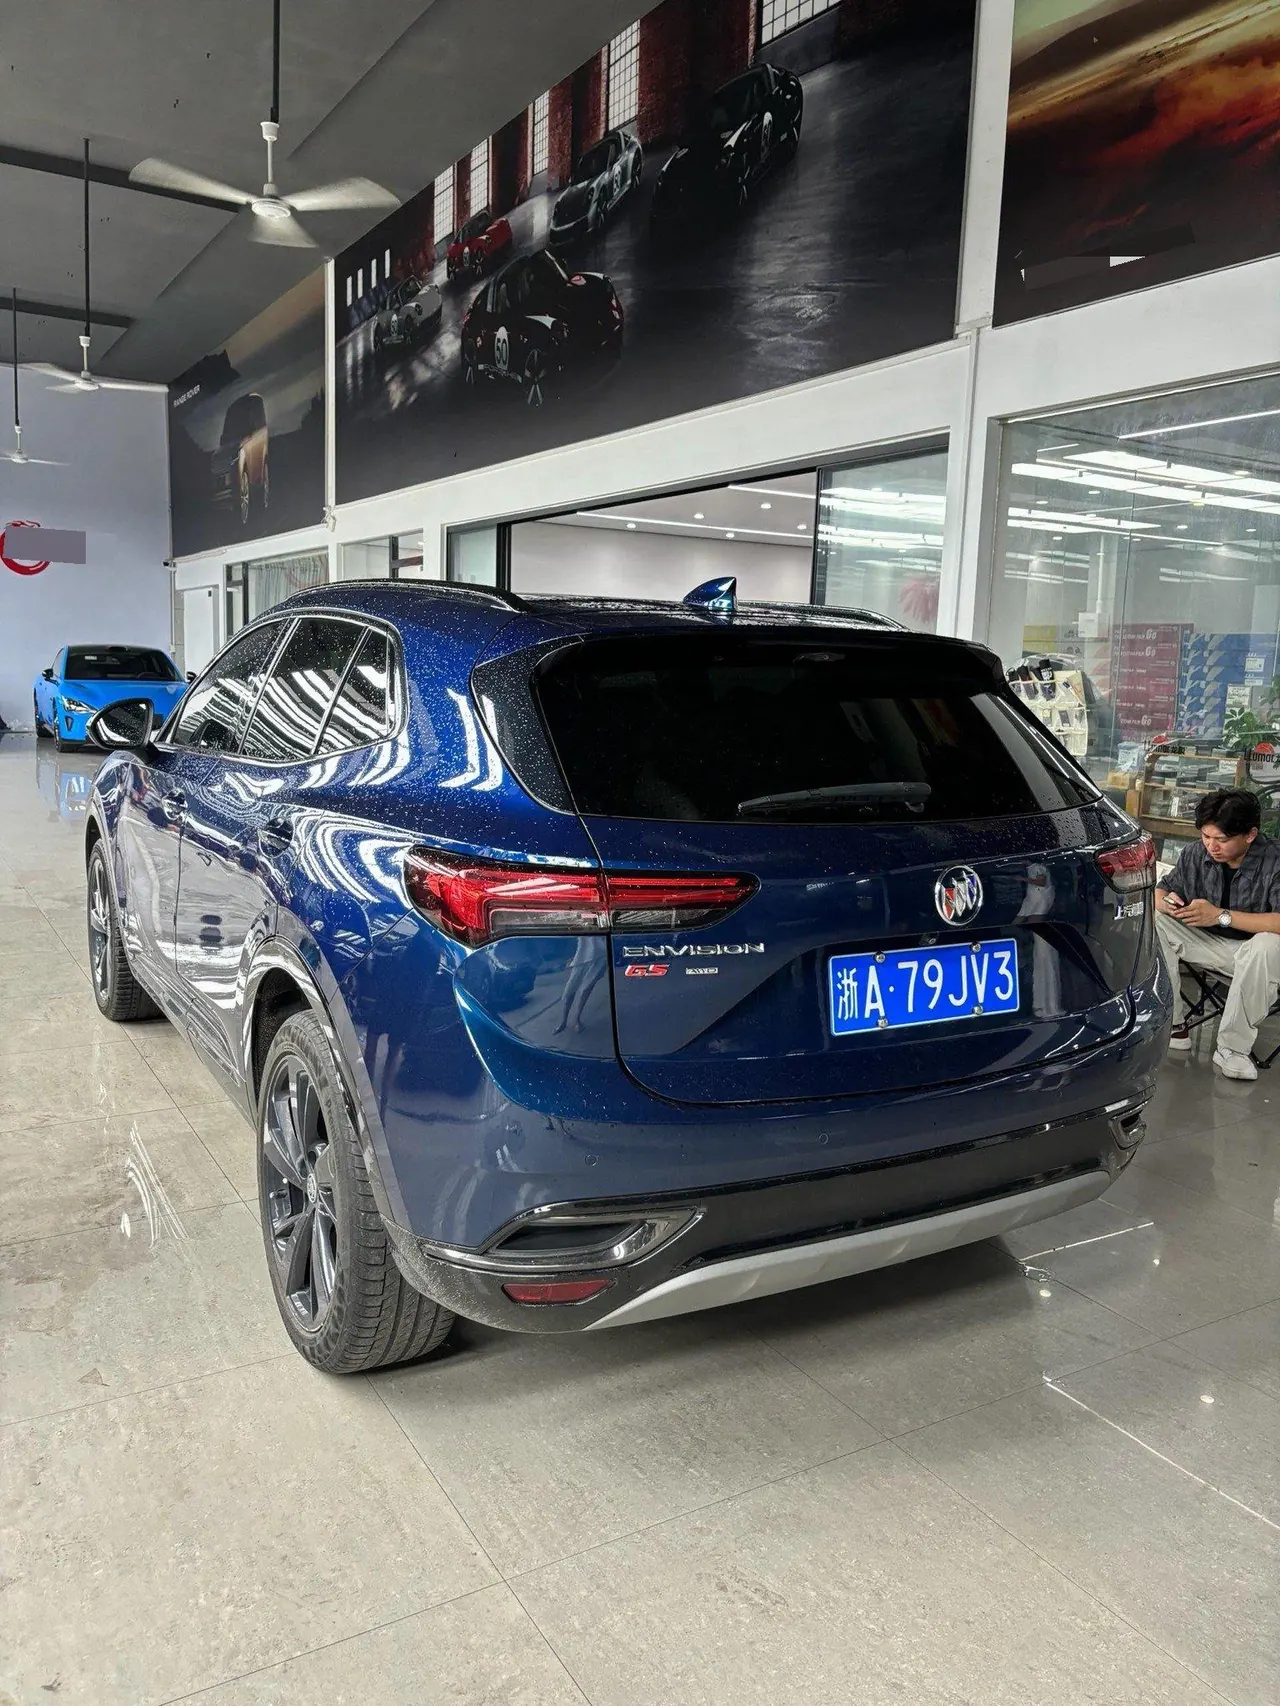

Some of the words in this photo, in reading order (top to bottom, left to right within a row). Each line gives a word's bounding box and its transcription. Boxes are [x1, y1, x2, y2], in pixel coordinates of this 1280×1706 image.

[173, 394, 187, 408] RANGE
[186, 384, 200, 400] ROVER
[623, 942, 765, 957] ENVISION
[624, 963, 670, 977] GS
[685, 967, 718, 975] AWD
